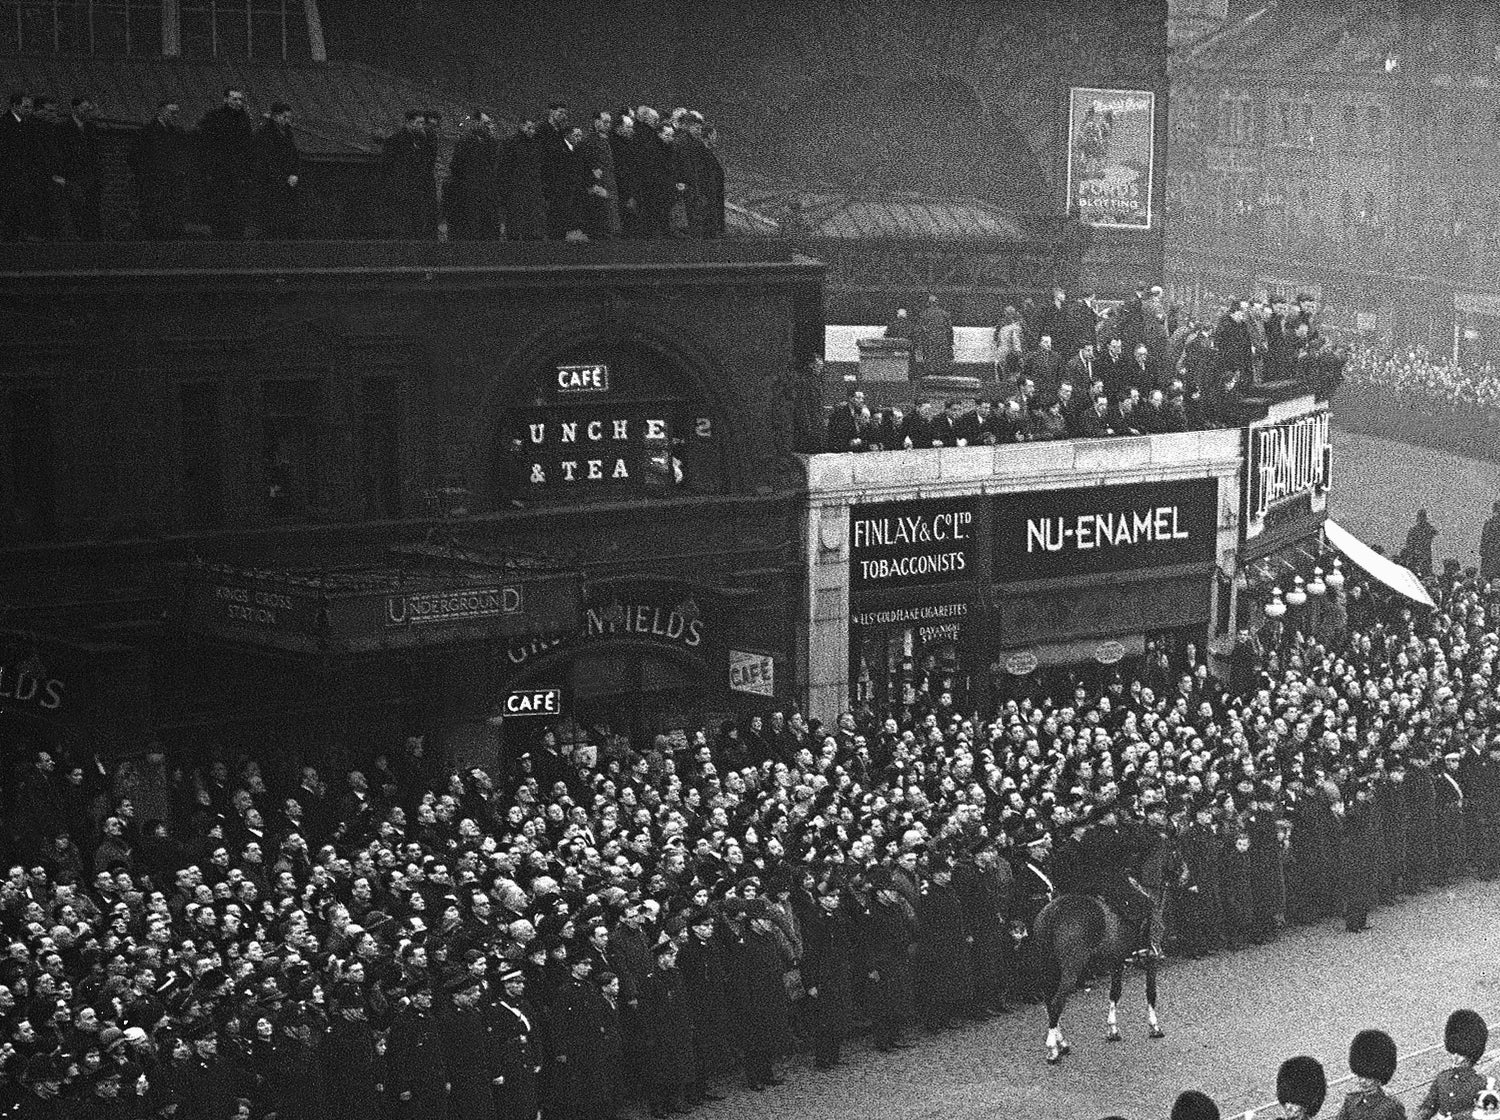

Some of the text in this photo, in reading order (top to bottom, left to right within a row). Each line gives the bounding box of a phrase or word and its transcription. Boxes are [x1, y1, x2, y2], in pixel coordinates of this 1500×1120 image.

[558, 367, 601, 388] CAFÉ
[530, 463, 545, 483] &
[854, 515, 922, 547] FINLAY
[919, 522, 932, 542] &
[1027, 506, 1189, 553] NU-ENAMEL
[860, 551, 966, 580] TOBACCONISTS
[388, 586, 520, 623] UNDERGROUND
[920, 602, 968, 619] CIGARETTES
[507, 690, 554, 712] CAFÉ
